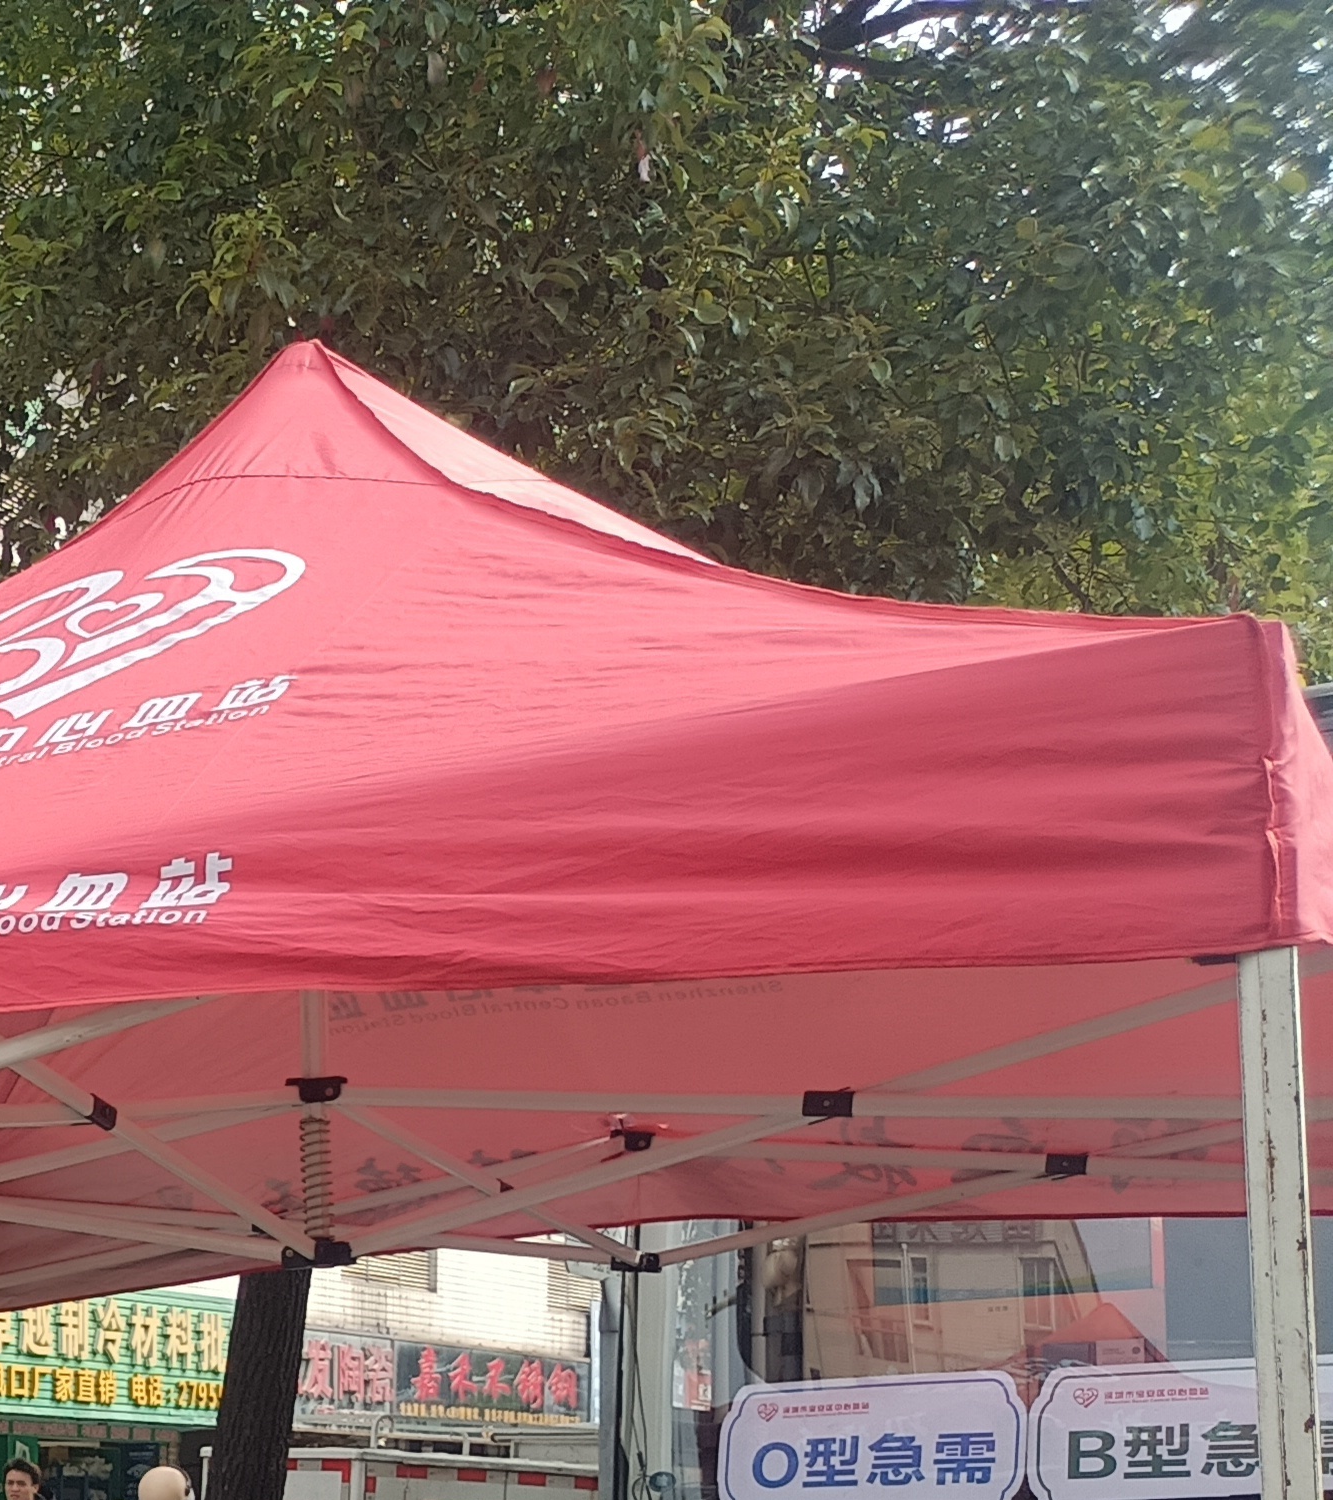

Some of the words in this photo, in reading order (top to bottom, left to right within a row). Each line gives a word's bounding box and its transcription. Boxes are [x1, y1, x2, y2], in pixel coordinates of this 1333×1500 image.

[52, 726, 147, 757] Blood
[150, 705, 270, 737] Station
[70, 906, 210, 931] Station
[752, 1432, 996, 1489] O型急需
